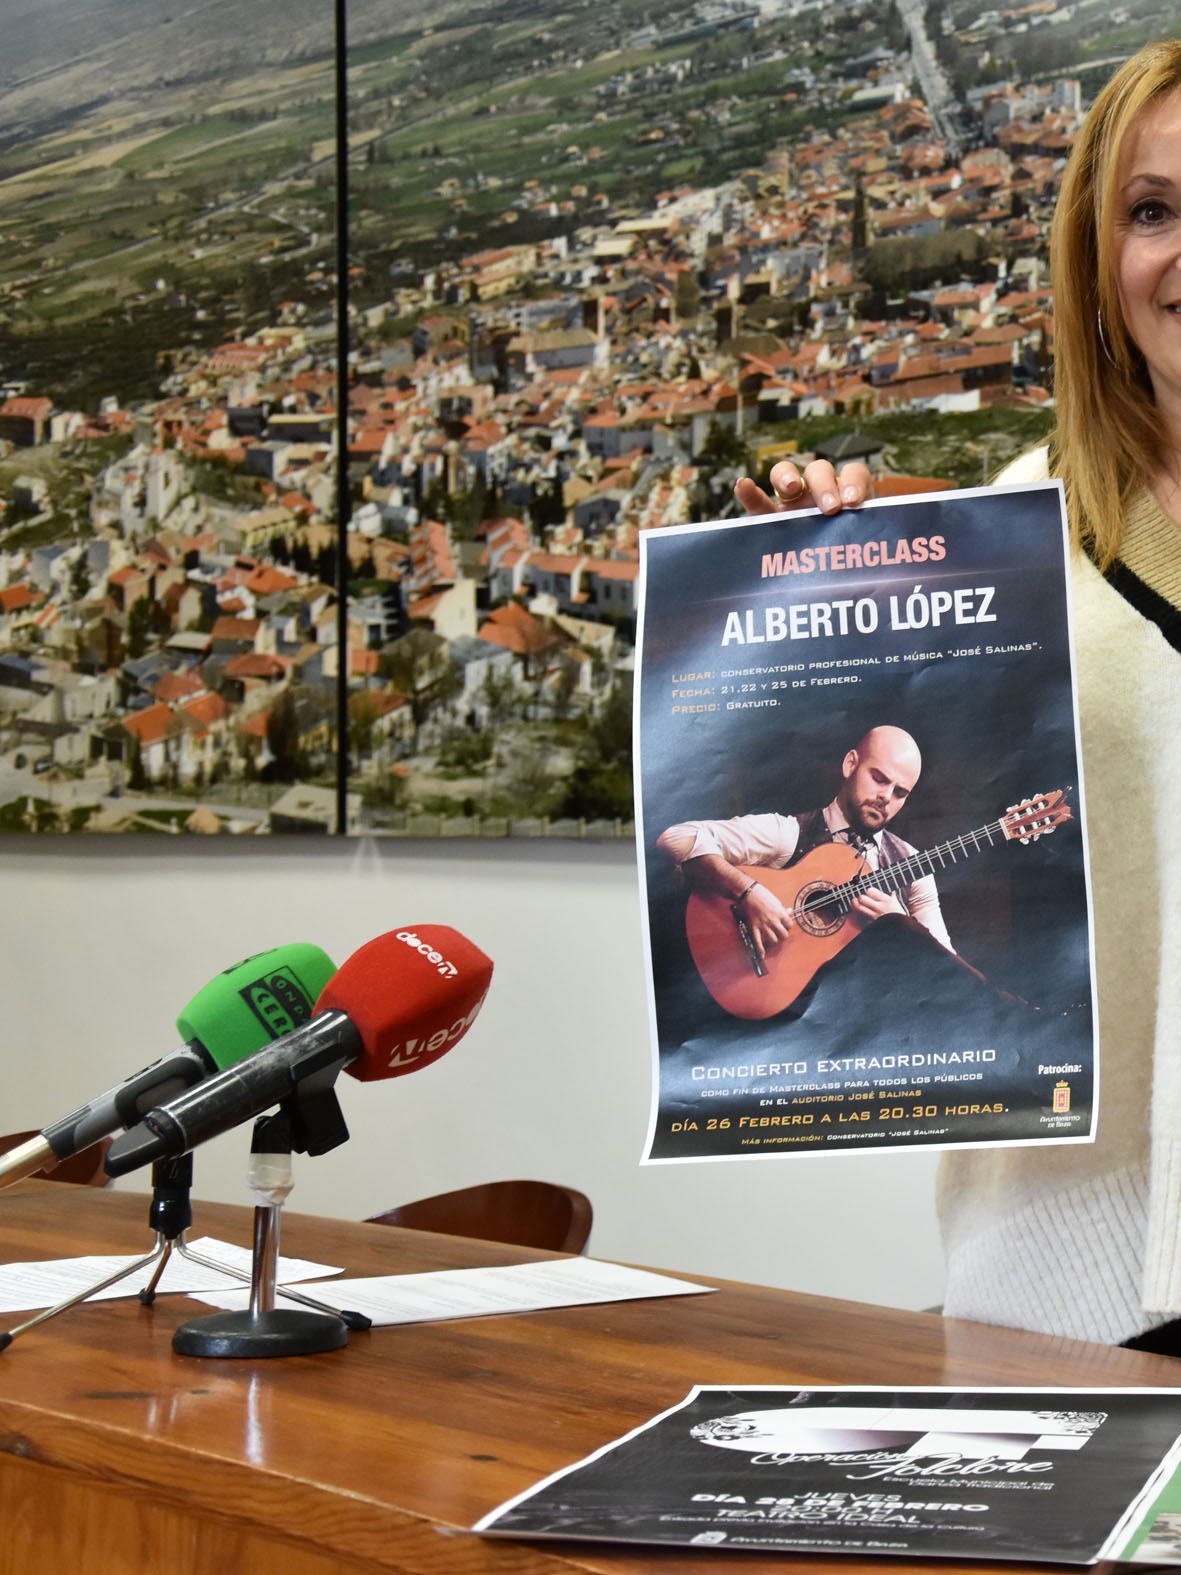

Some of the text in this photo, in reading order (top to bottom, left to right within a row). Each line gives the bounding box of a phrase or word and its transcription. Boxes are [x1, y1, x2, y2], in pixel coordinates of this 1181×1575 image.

[760, 535, 947, 578] MASTERCLASS
[720, 584, 997, 647] ALBERTO LÓPEZ
[672, 671, 716, 684] LUGAR:
[720, 663, 805, 679] CONSERVATORIO
[808, 656, 881, 670] PROFESIONAL
[885, 655, 900, 665] DE
[903, 650, 943, 662] MÚSICA
[672, 675, 862, 699] FECHA: Y 25 DE FEBRERO.
[672, 699, 782, 715] PRECIO: GRATUITO.
[691, 1049, 997, 1081] CONCIERTO EXTRAORDINARIO
[700, 1072, 983, 1098] COMO FIN DE MASTERCLASS PARA TODOS LOS PÚBLICOS
[759, 1089, 922, 1107] EN EL AUDITORIO JOSÉ SALINAS
[671, 1103, 1009, 1133] DÍA 26 FEBRERO A LAS 20.30 HORAS.
[741, 1131, 886, 1145] MÁS INFORMACIÓN: CONSERVATORIO
[846, 1452, 1053, 1480] Folclore
[691, 1494, 747, 1504] DÍA
[851, 1501, 989, 1511] FEBRERO
[793, 1492, 901, 1501] JUEVES
[716, 1509, 828, 1520] TEATRO
[836, 1512, 921, 1523] IDEAL
